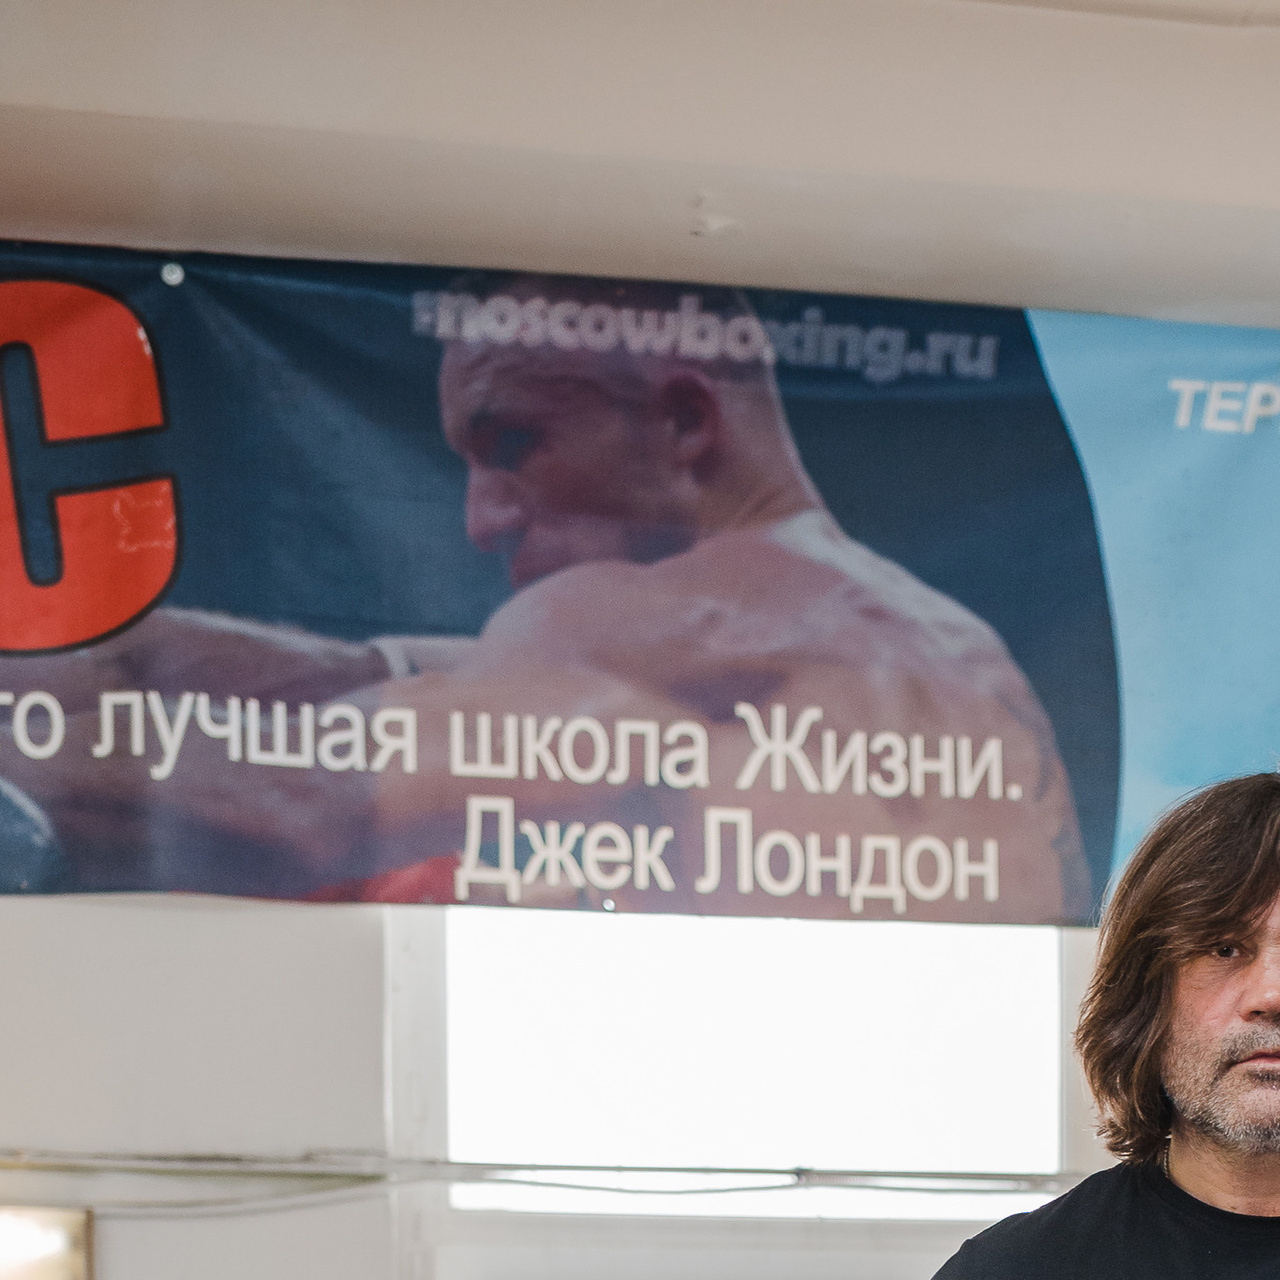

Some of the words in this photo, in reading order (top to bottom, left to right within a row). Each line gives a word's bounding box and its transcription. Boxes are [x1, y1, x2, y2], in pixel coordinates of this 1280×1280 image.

[412, 289, 997, 381] moscowboxing.ru
[92, 689, 418, 781] лучшая
[449, 708, 710, 790] школа
[736, 702, 1023, 800] Жизни.
[455, 797, 675, 902] Джек
[694, 806, 999, 914] Лондон
